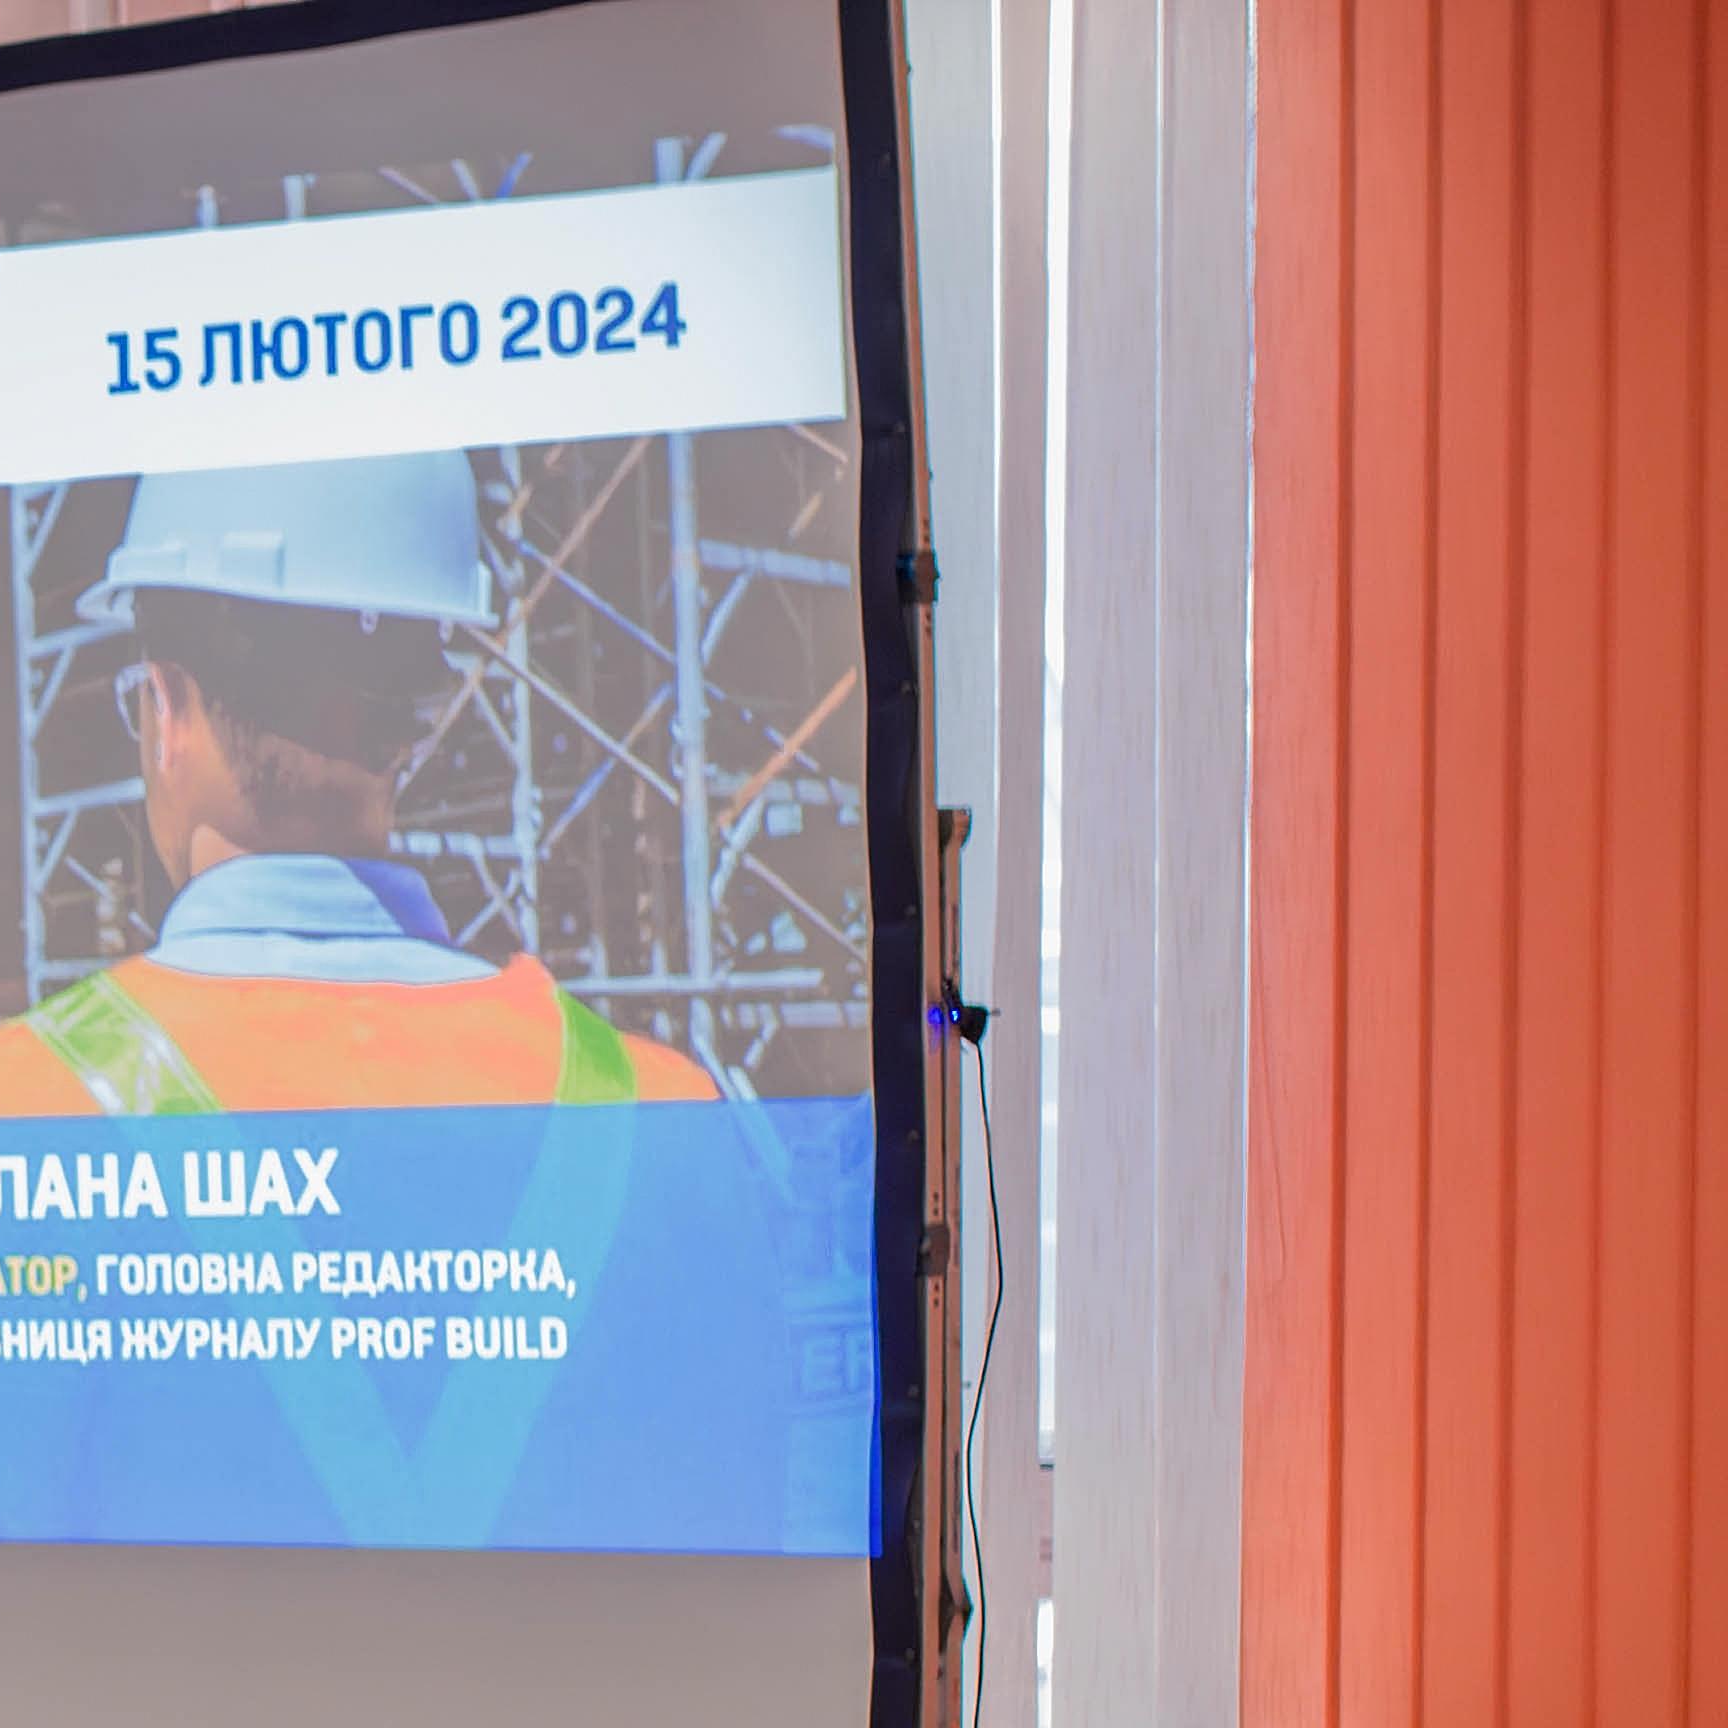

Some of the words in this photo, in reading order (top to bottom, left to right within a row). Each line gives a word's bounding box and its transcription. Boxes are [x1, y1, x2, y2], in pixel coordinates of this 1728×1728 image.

[106, 327, 183, 396] 15
[198, 300, 481, 388] ЛЮТОГО
[500, 281, 688, 361] 2024
[183, 1148, 341, 1217] ШАХ
[96, 1252, 284, 1295] ГОЛОВНА
[292, 1248, 576, 1299] РЕДАКТОРКА,
[120, 1318, 321, 1361] ЖУРНАЛУ
[331, 1317, 436, 1359] PROF
[446, 1315, 568, 1359] BUILD
